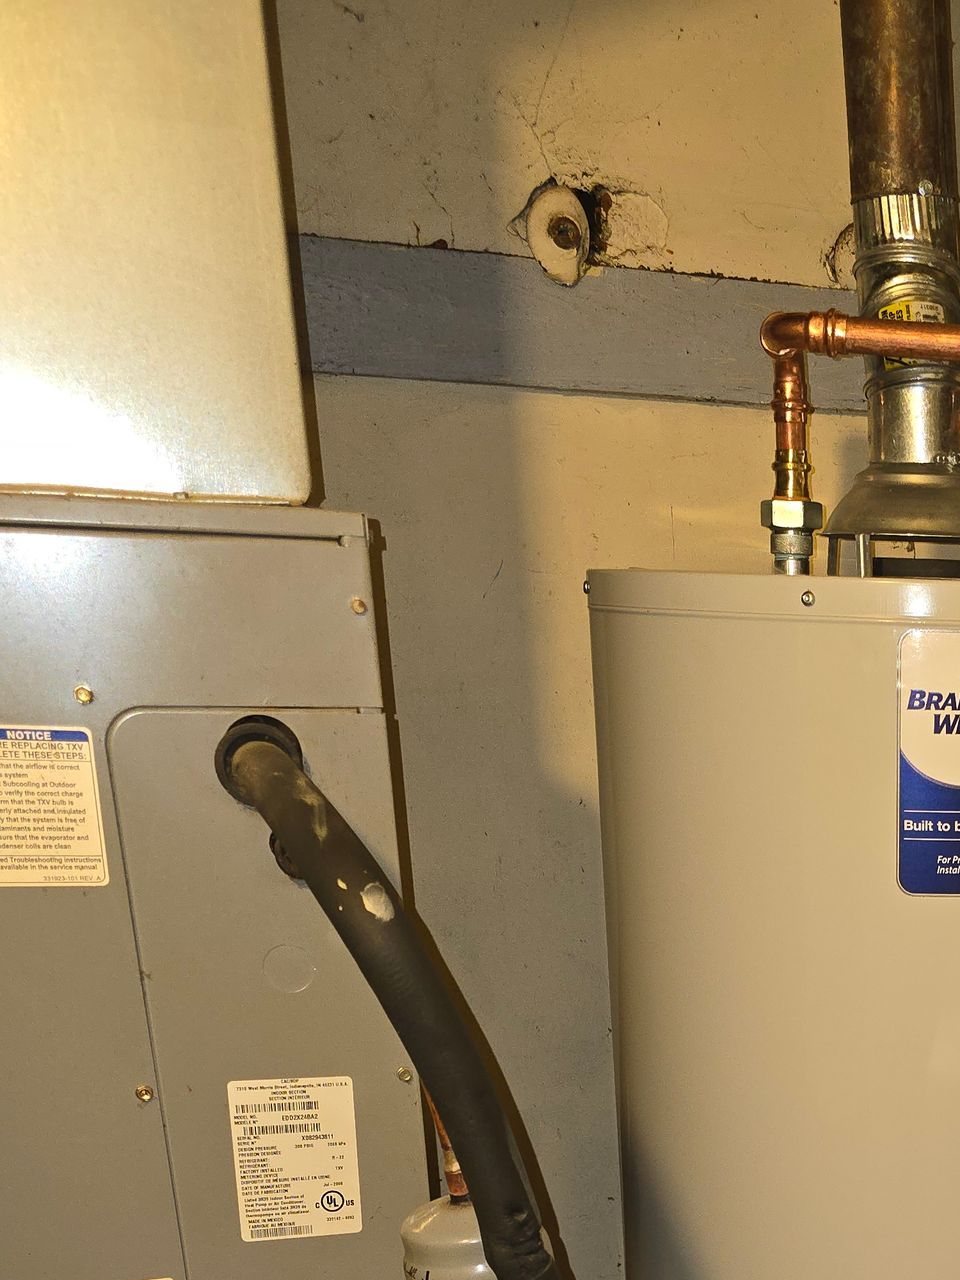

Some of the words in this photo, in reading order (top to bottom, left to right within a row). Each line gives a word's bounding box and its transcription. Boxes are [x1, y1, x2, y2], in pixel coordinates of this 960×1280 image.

[6, 730, 52, 740] NOTICE
[11, 741, 64, 750] REPLACING
[66, 743, 83, 751] TXV
[22, 751, 52, 759] THESE
[53, 752, 87, 760] STEPS:
[904, 819, 933, 832] Built
[937, 821, 951, 832] to
[937, 855, 951, 864] For
